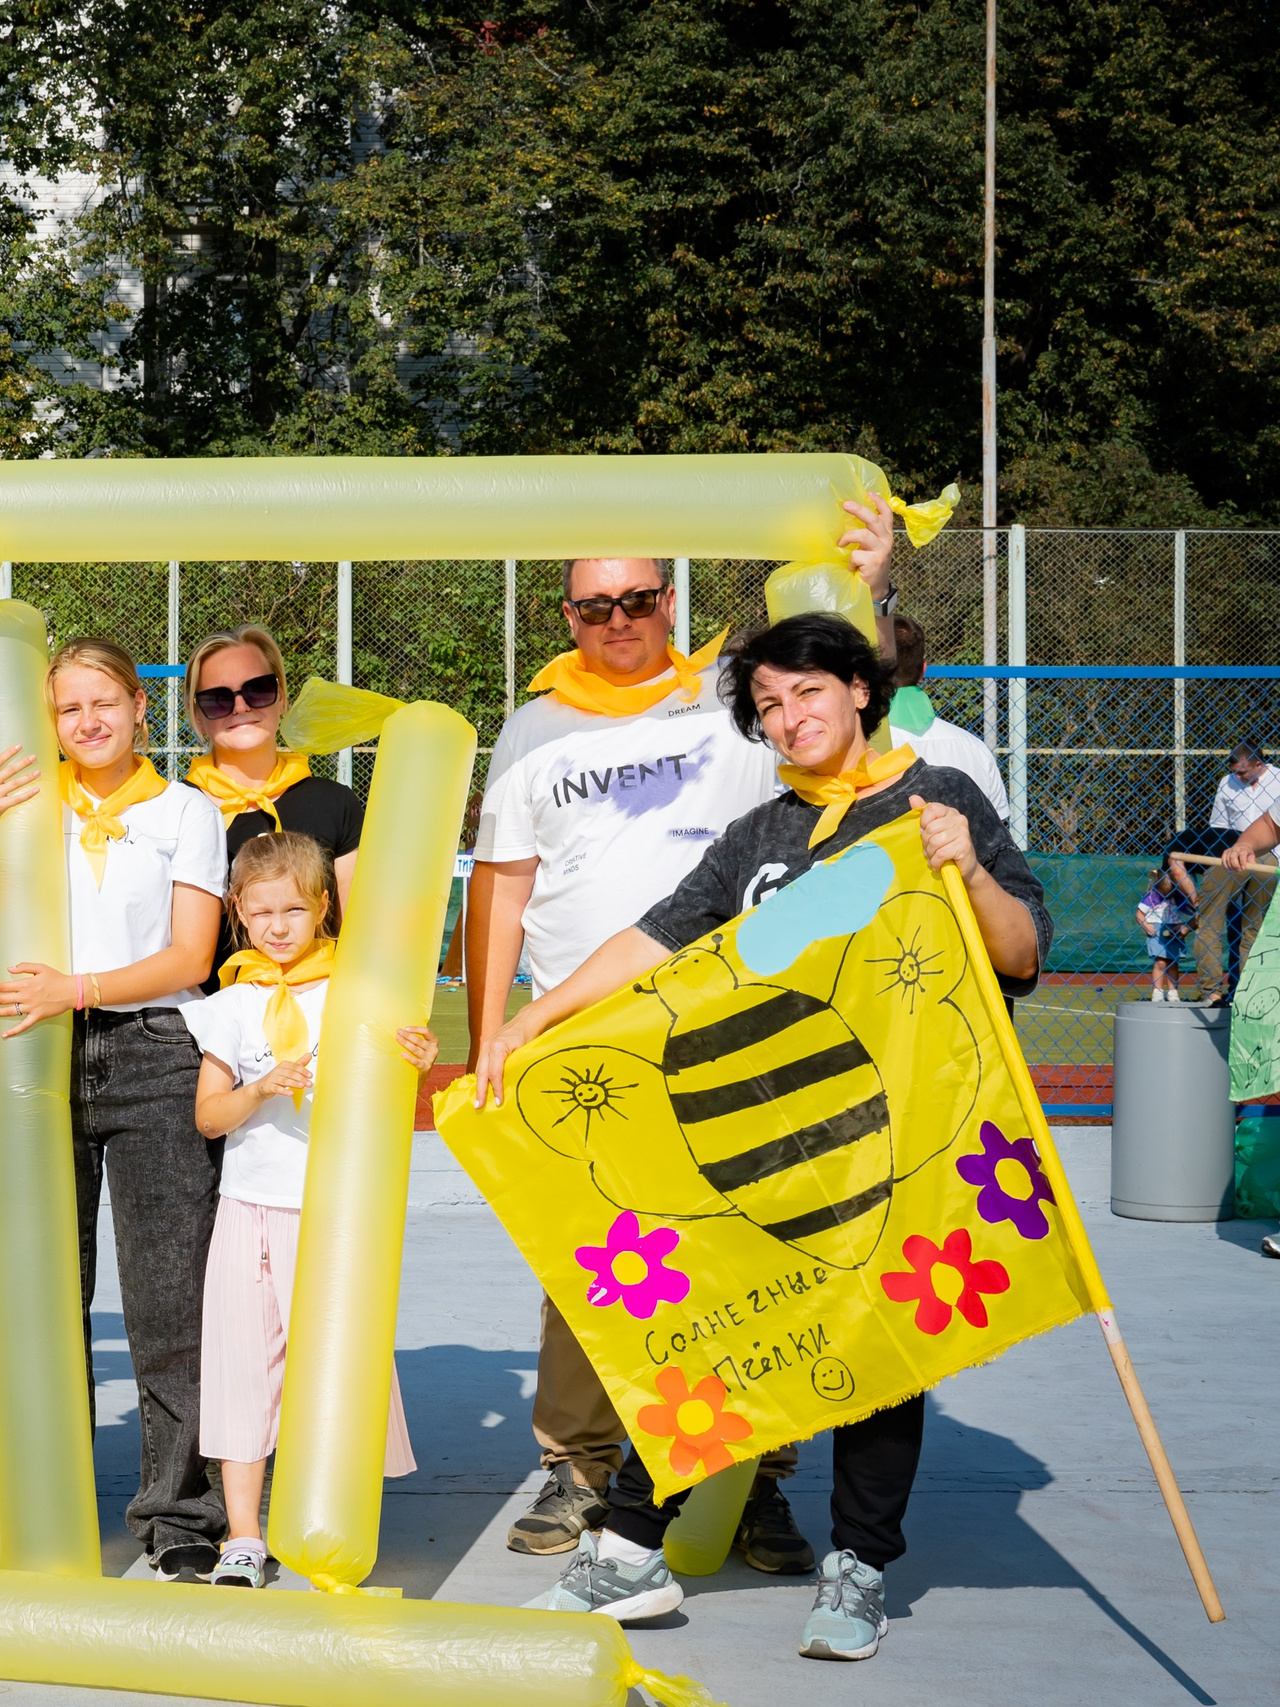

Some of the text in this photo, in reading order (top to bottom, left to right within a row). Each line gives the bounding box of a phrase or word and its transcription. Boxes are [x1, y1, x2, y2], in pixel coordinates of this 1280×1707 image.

[668, 703, 701, 717] DREAM
[552, 753, 687, 808] INVENT
[672, 827, 710, 838] IMAGINE
